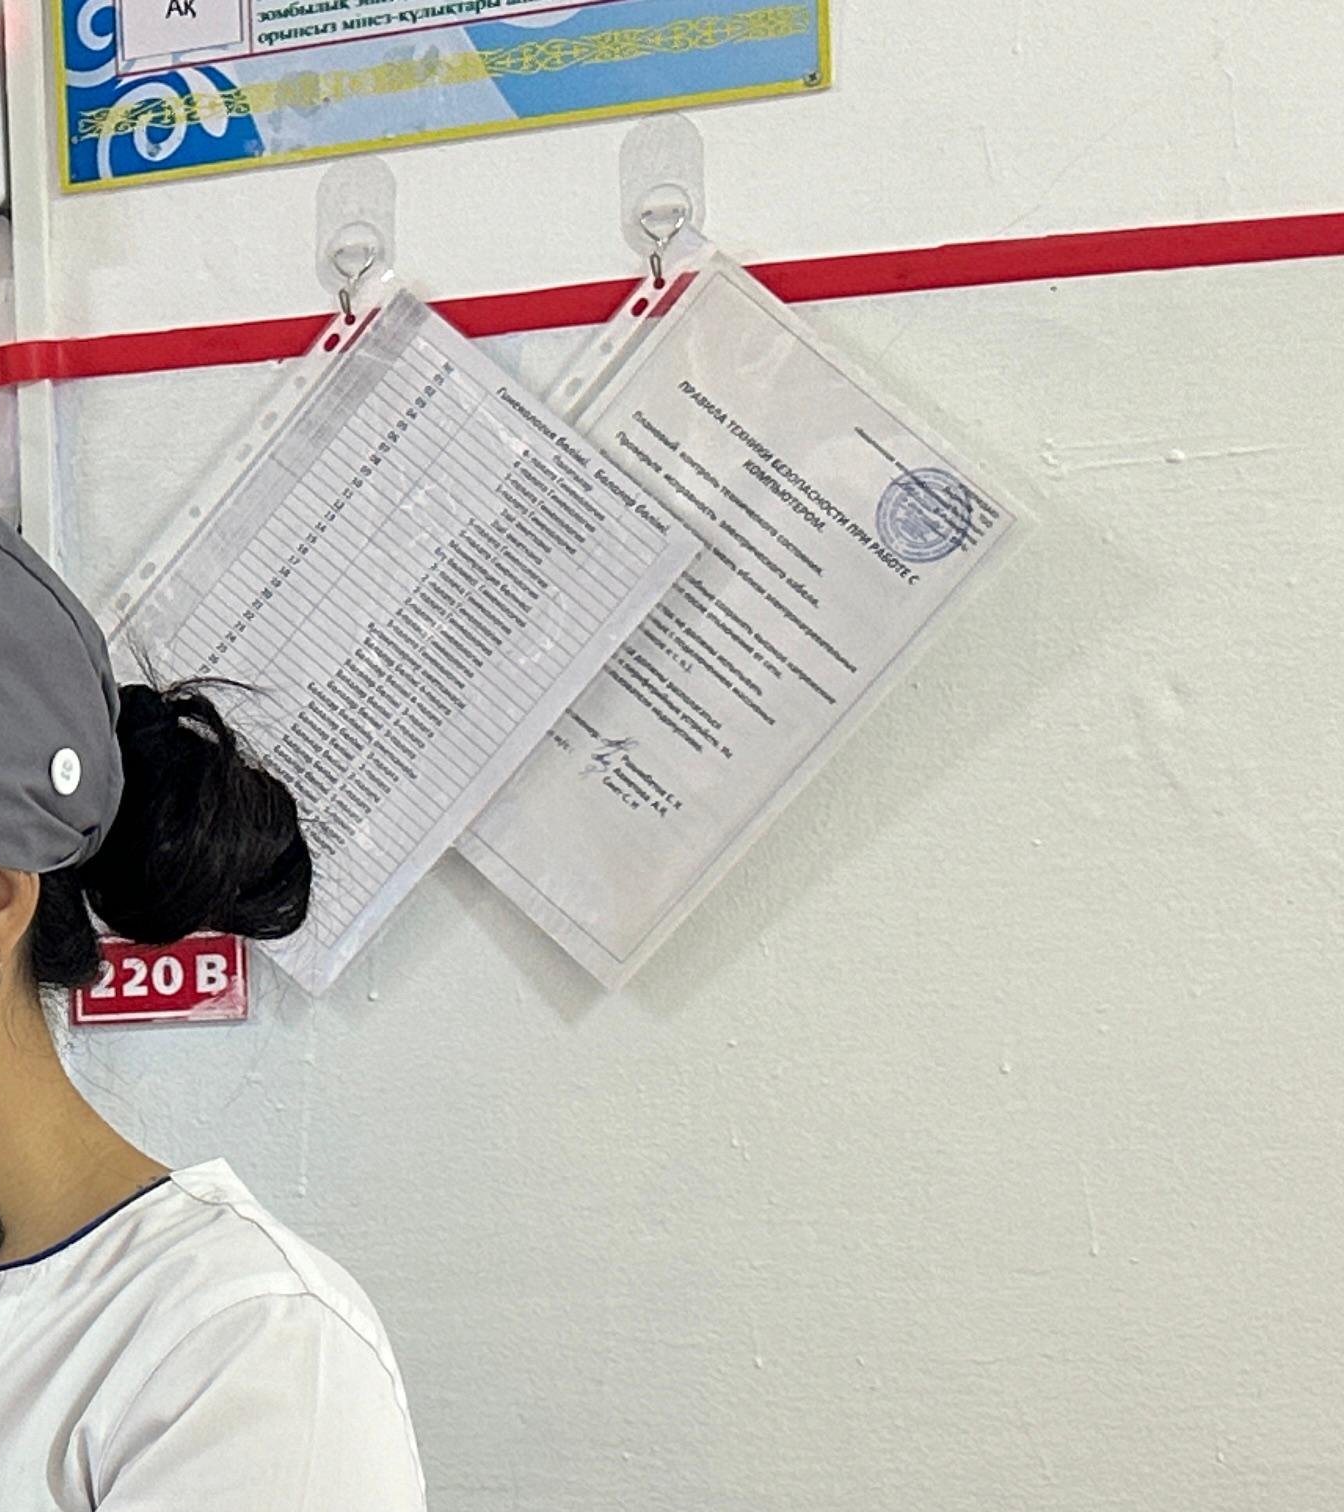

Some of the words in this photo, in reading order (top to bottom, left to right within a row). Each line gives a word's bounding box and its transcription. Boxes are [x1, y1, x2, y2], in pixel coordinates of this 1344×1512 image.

[257, 22, 337, 46] орынсыз
[495, 386, 557, 440] Гинекология
[677, 380, 727, 424] ПРАВИЛА
[726, 419, 773, 461] ТЕХНИКИ
[770, 458, 850, 526] БЕЗОПАСНОСТИ
[845, 522, 871, 545] ПРИ
[867, 541, 911, 578] РАБОТЕ
[741, 458, 826, 533] КОМПЬЮТЕРОМ.
[90, 956, 184, 998] 220
